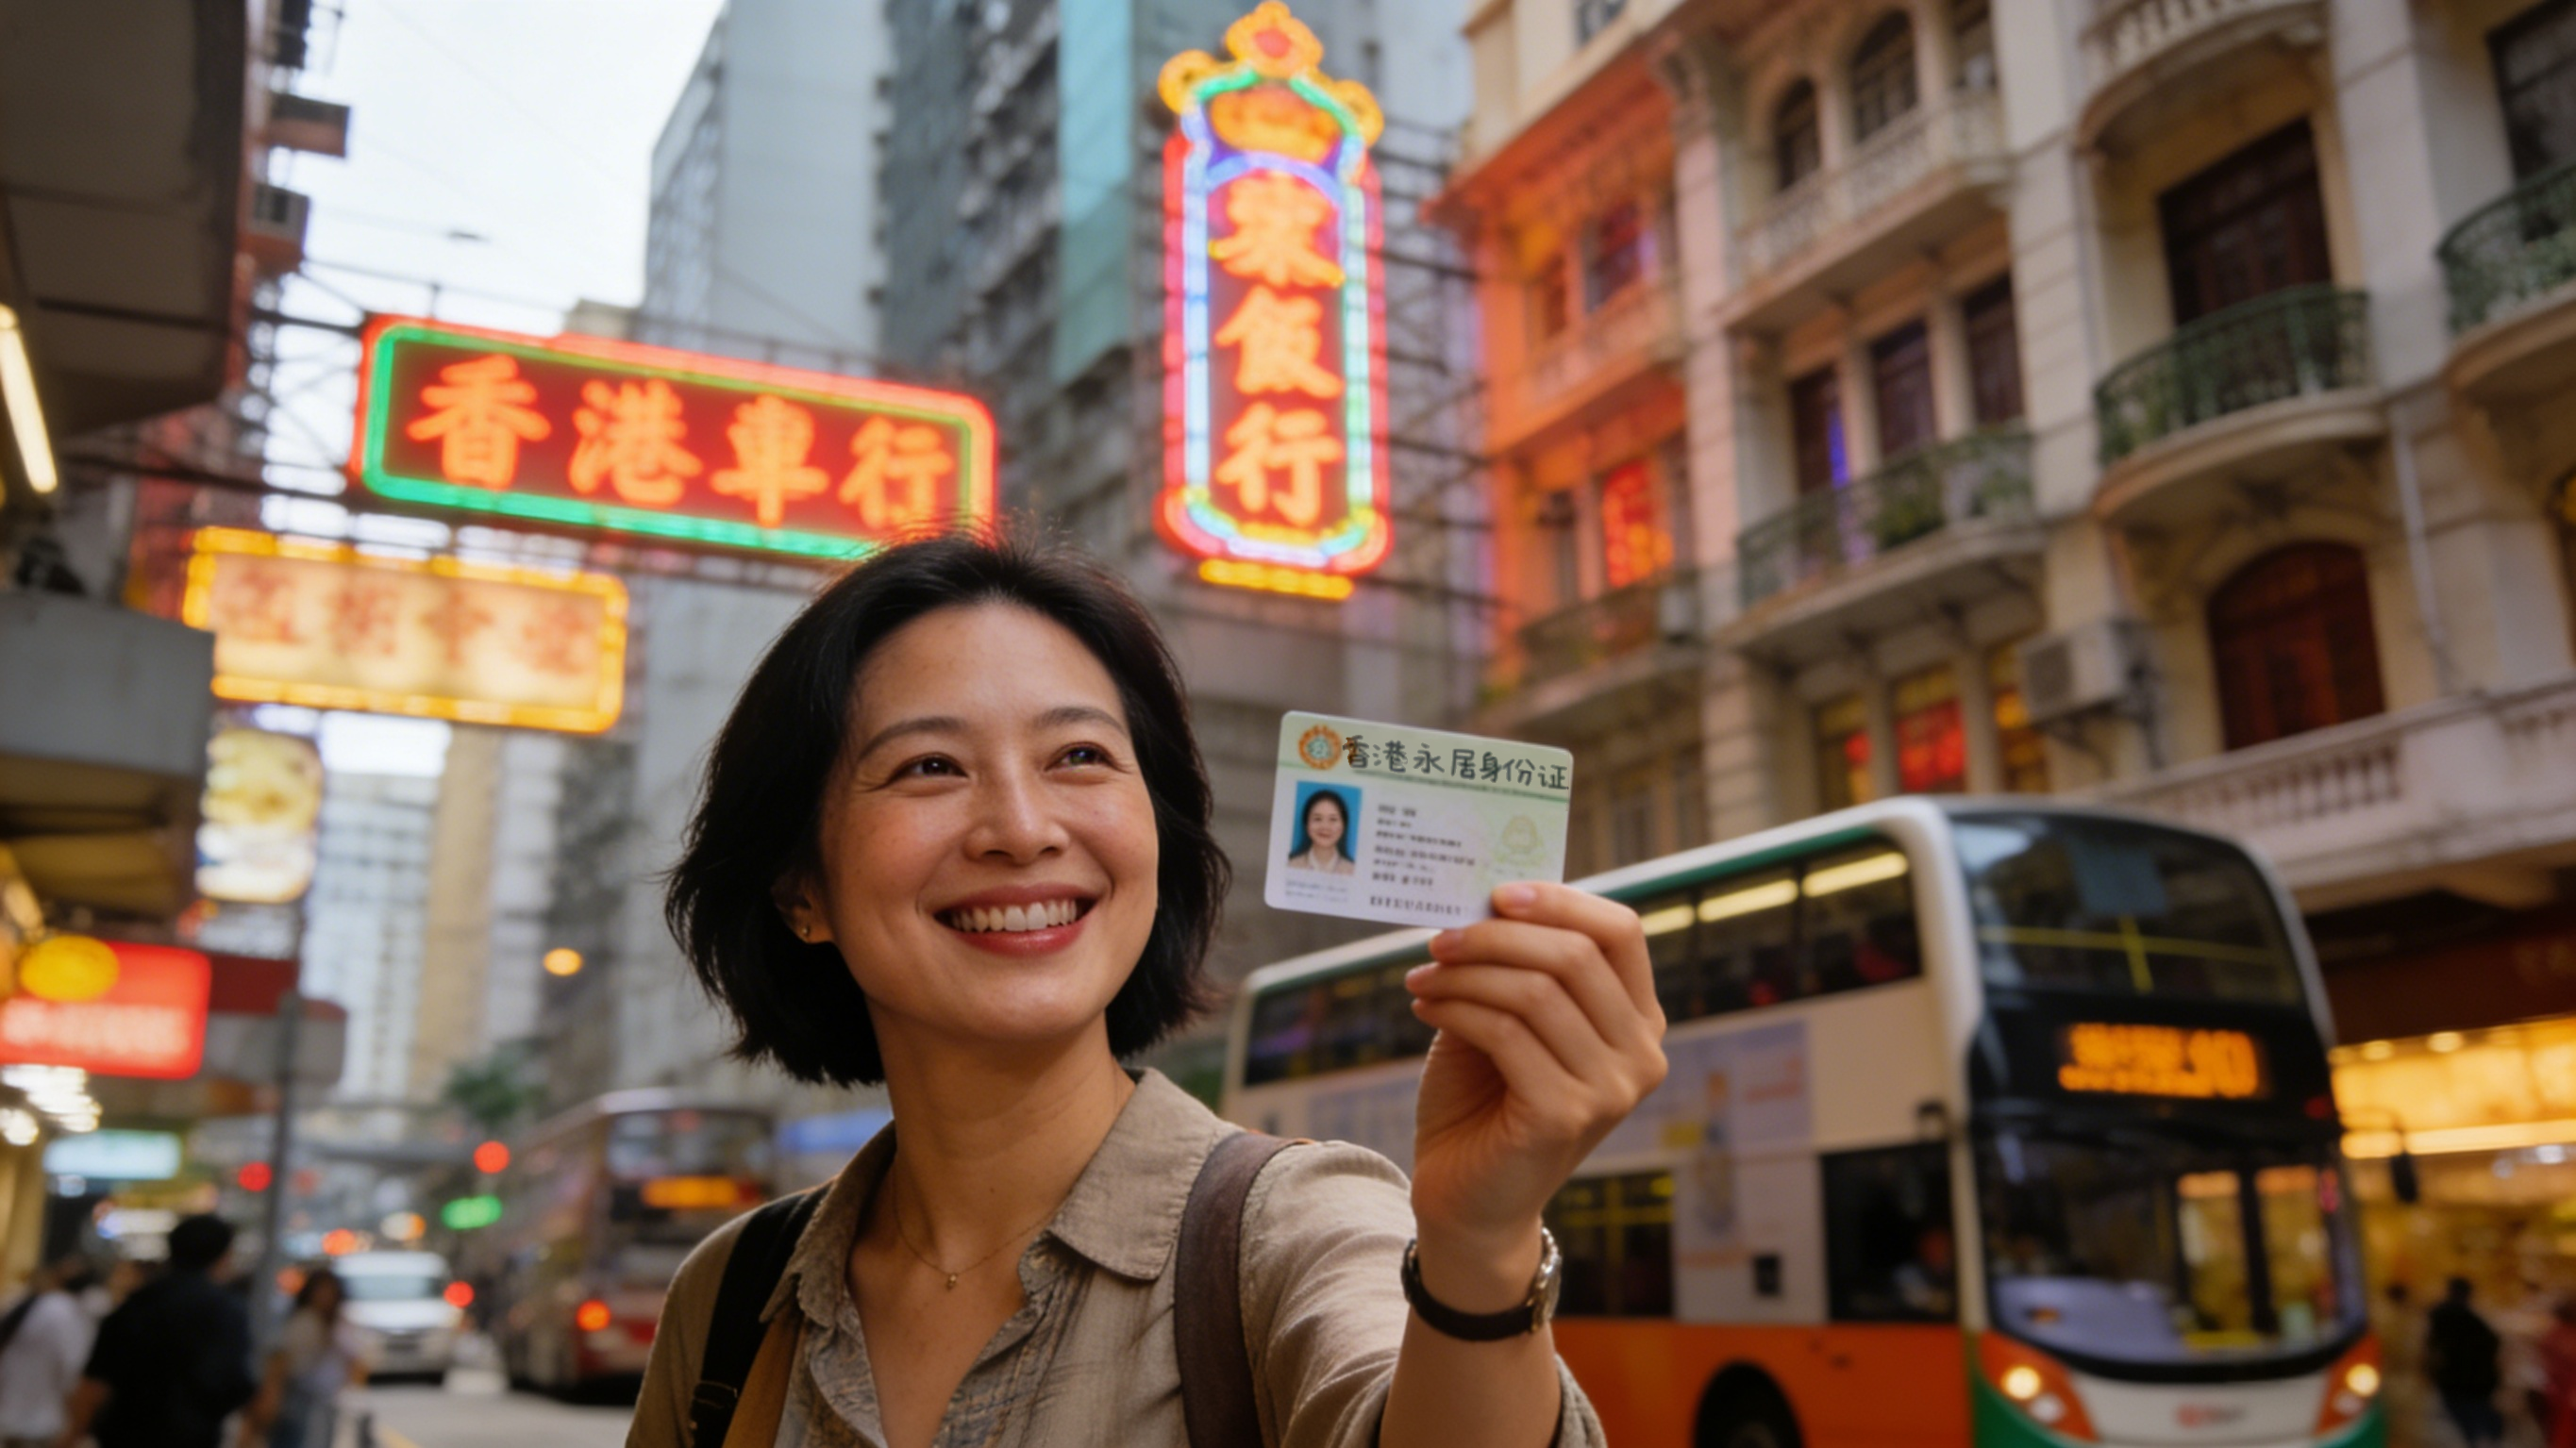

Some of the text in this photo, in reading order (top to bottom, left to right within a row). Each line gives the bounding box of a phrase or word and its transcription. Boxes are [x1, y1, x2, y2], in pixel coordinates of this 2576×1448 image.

[1343, 735, 1569, 790] 香港永居身份证
